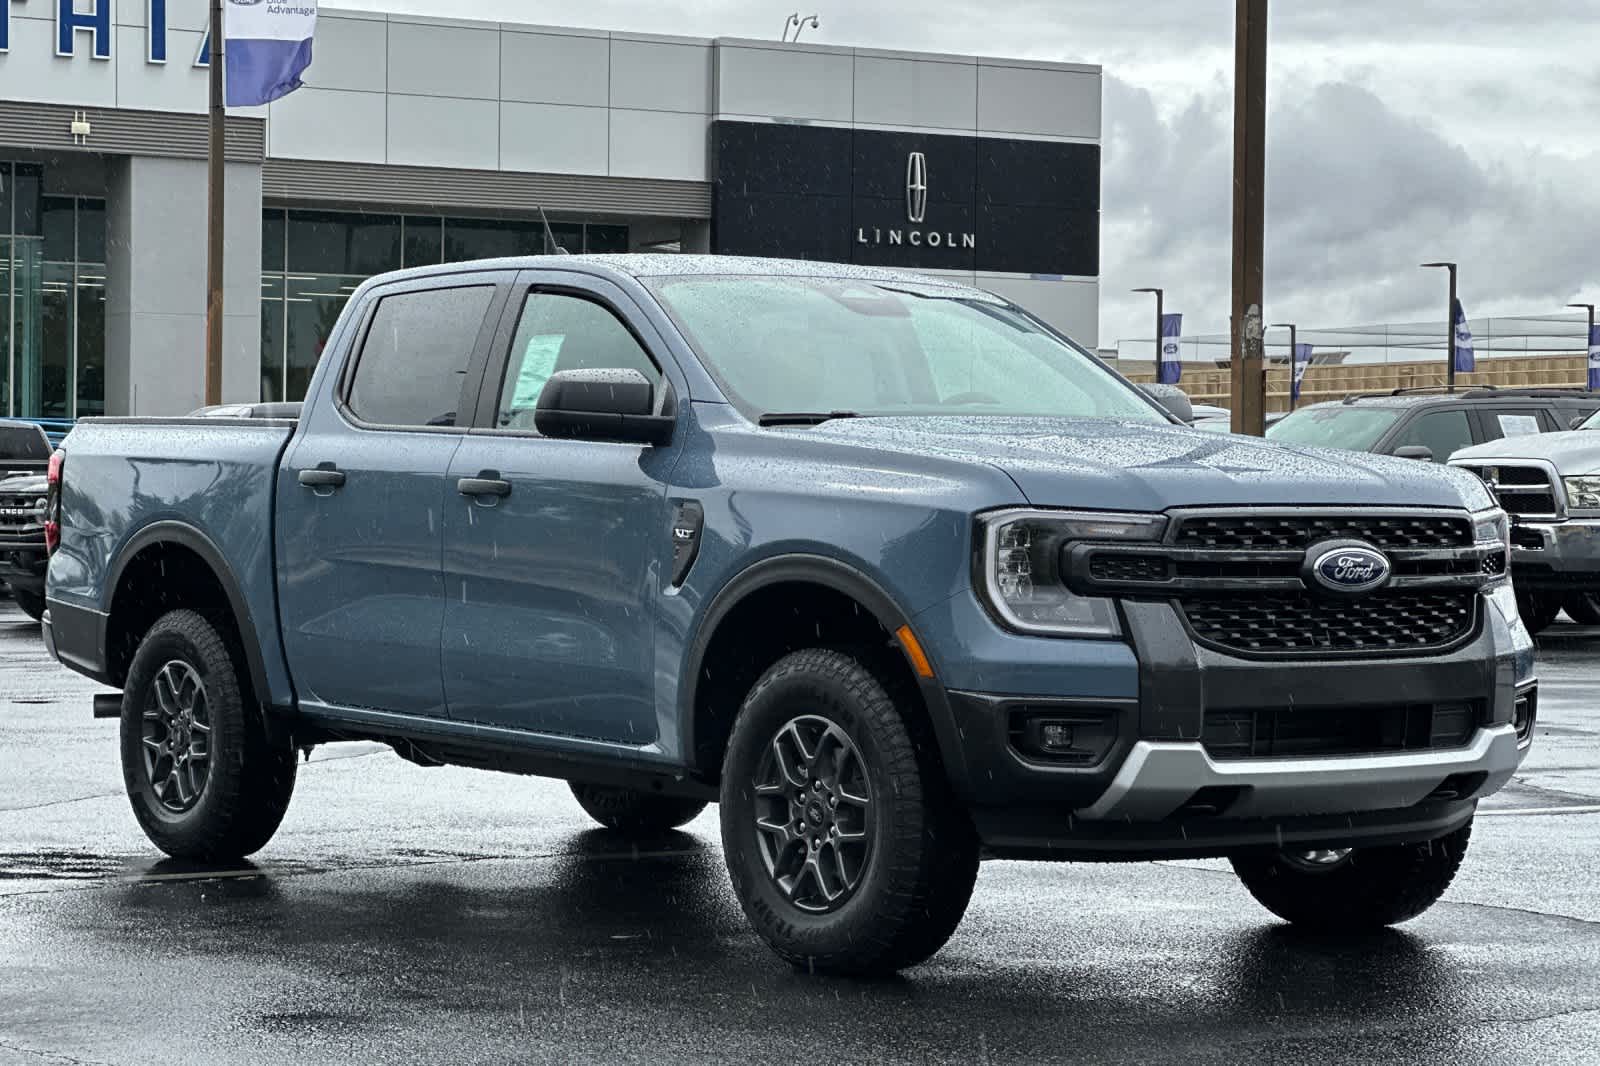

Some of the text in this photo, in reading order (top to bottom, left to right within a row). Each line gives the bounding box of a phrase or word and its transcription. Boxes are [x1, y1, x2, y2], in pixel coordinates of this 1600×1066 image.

[266, 5, 315, 16] Advantage
[858, 228, 975, 248] LINCOLN
[1334, 556, 1374, 579] Ford
